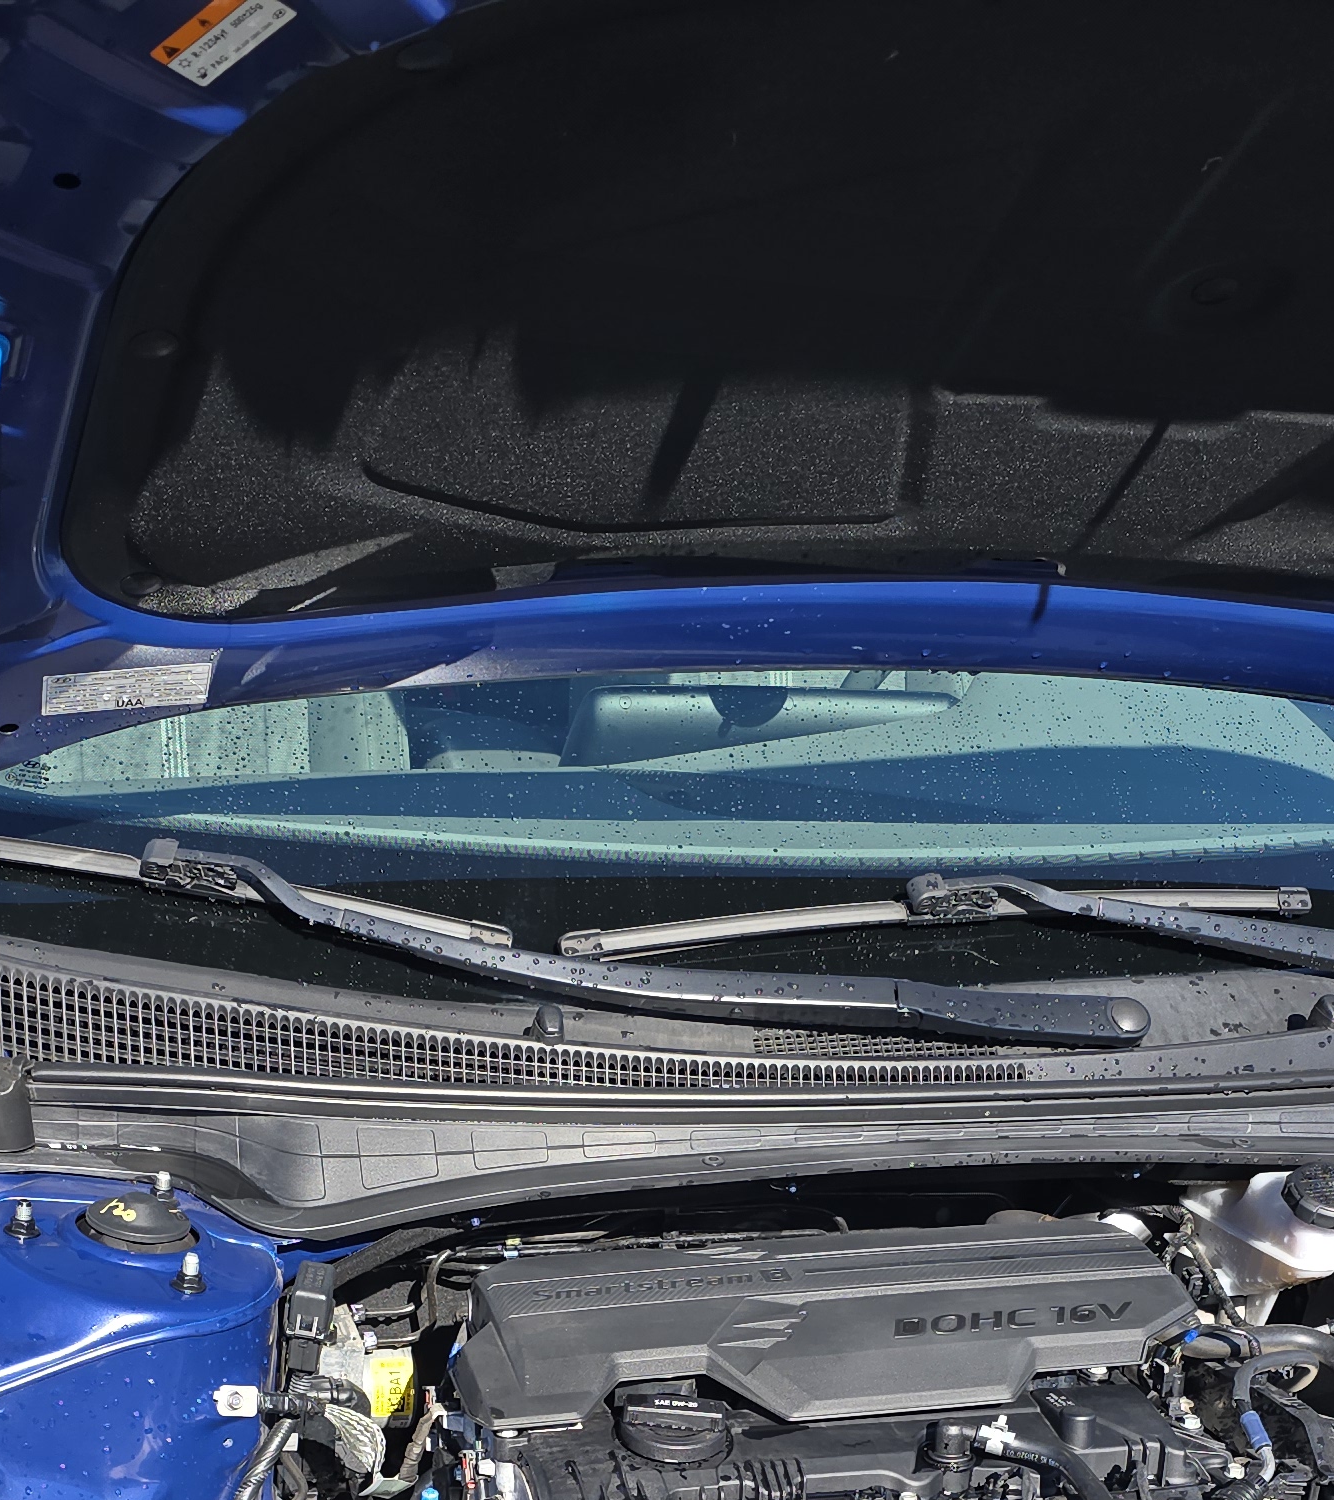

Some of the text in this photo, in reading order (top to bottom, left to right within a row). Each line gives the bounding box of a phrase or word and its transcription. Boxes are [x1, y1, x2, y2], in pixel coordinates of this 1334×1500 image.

[210, 54, 229, 69] PAG
[116, 698, 144, 708] UAA
[532, 1273, 753, 1301] Smartstream
[893, 1301, 1133, 1339] DOHC 16V
